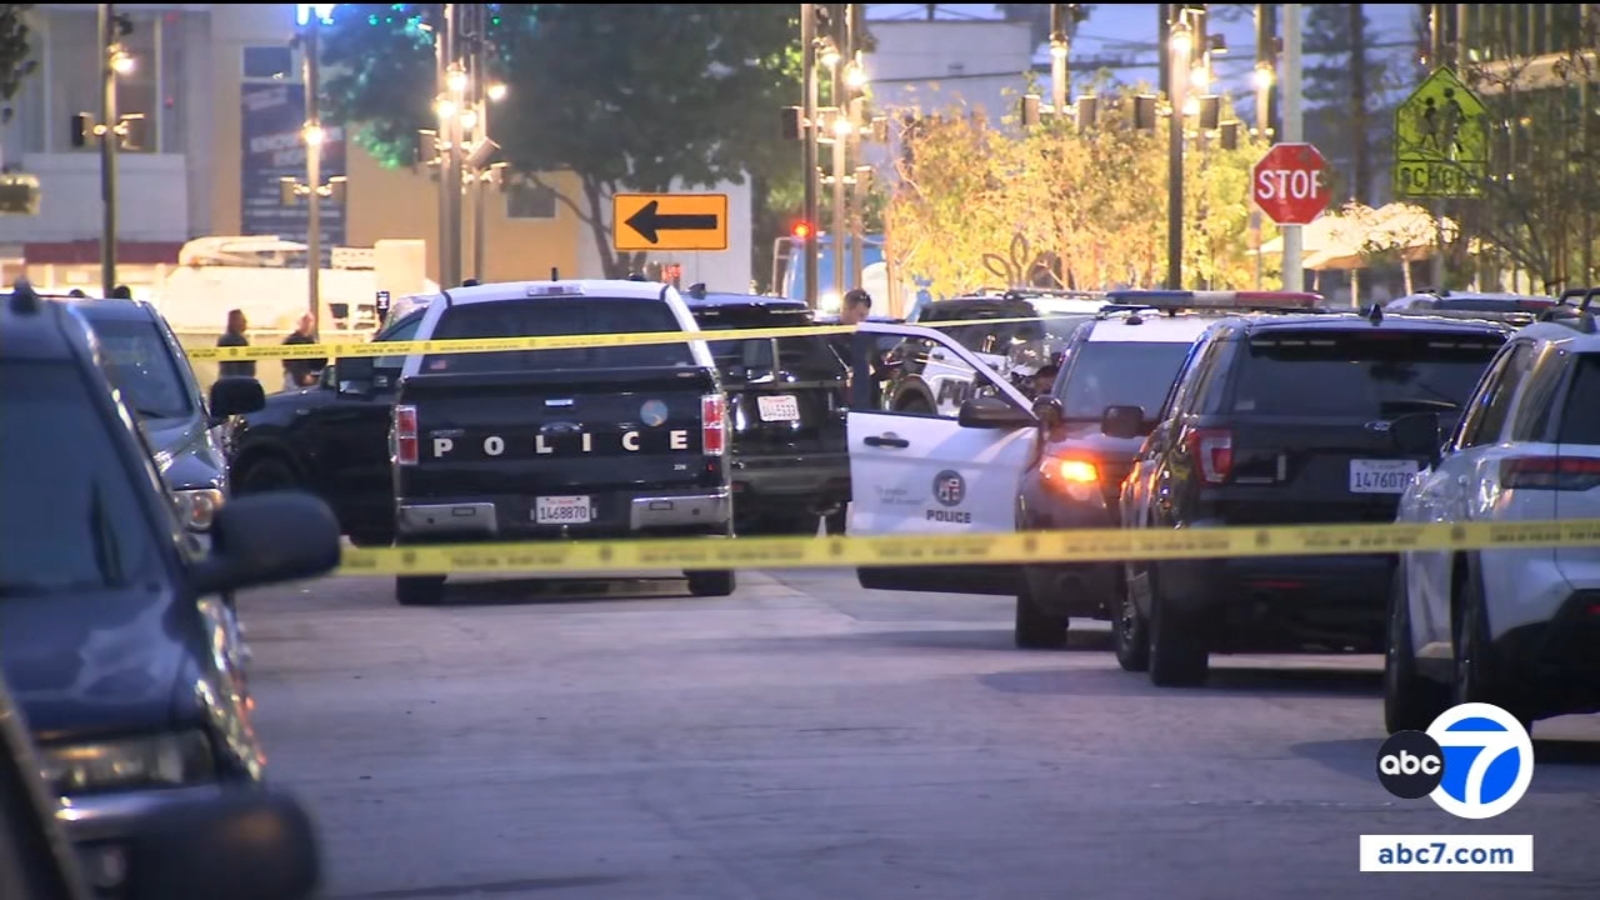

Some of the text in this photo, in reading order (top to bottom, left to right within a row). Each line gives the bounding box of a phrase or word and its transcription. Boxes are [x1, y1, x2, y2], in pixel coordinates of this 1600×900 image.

[433, 429, 688, 457] POLICE
[540, 506, 587, 520] 1468870
[926, 509, 972, 524] POLICE
